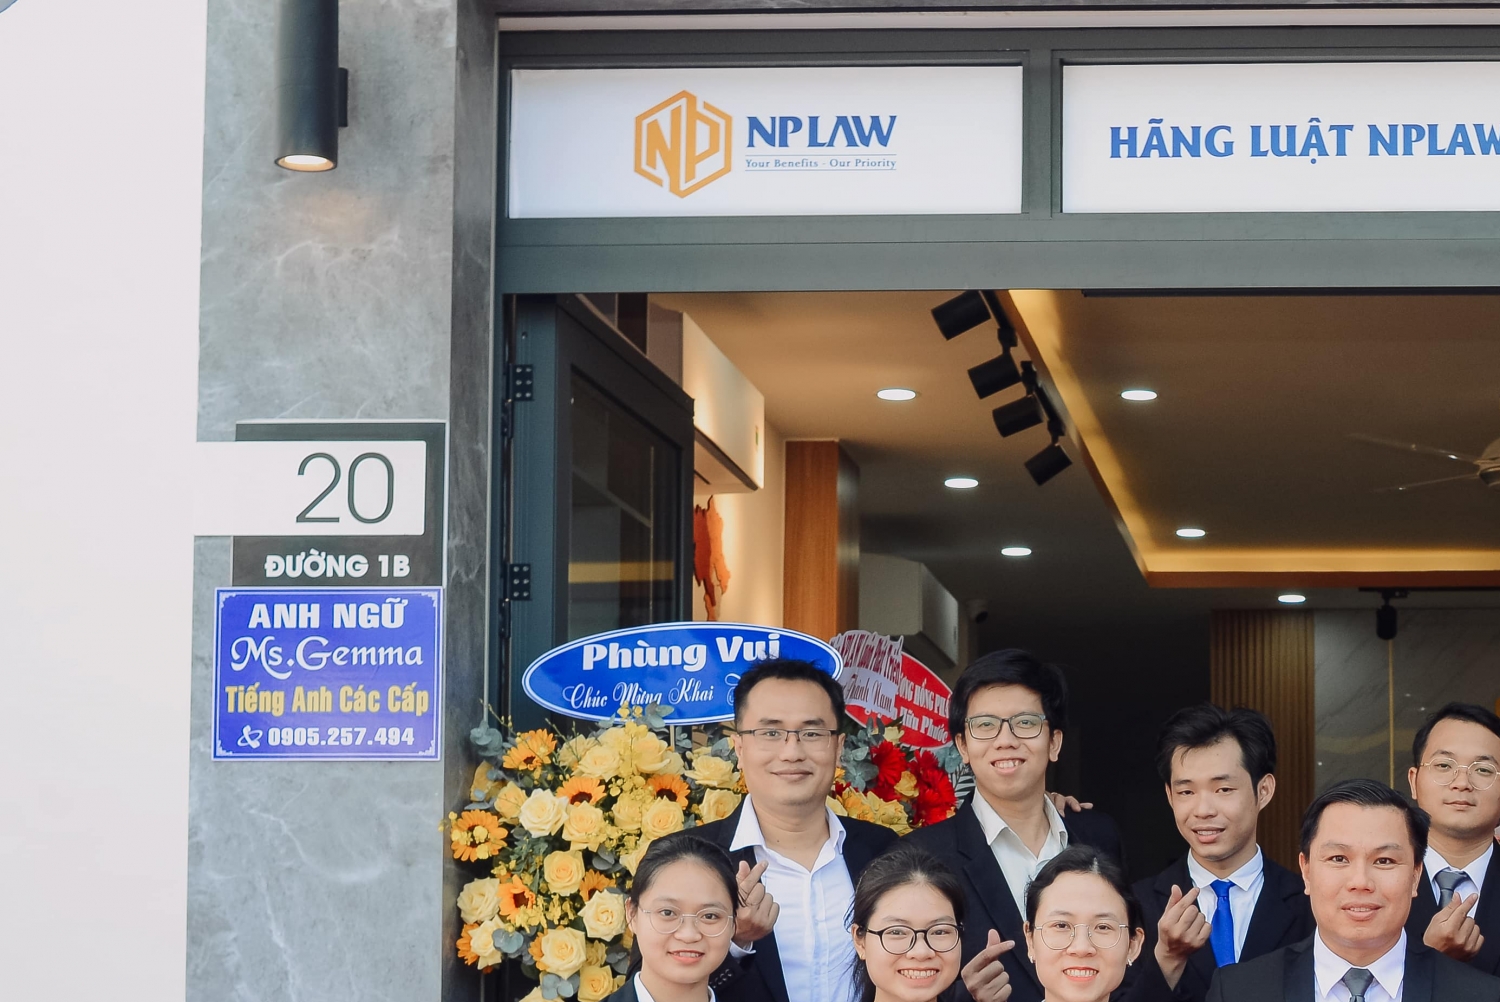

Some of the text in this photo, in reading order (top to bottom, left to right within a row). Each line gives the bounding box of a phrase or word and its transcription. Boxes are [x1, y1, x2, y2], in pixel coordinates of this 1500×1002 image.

[1109, 117, 1235, 159] HÃNG
[1250, 117, 1354, 165] LUẬT
[745, 157, 897, 171] Your Benefits Our Priority
[295, 452, 394, 524] 20
[264, 548, 411, 578] ĐƯỜNG 1B
[248, 597, 408, 629] ANH NGỮ
[582, 639, 707, 672] Phùng
[225, 682, 429, 717] Tiếng Anh Các Cấp
[562, 683, 608, 709] Chúc
[668, 677, 714, 704] Khai
[268, 727, 415, 746] 0905.257.494
